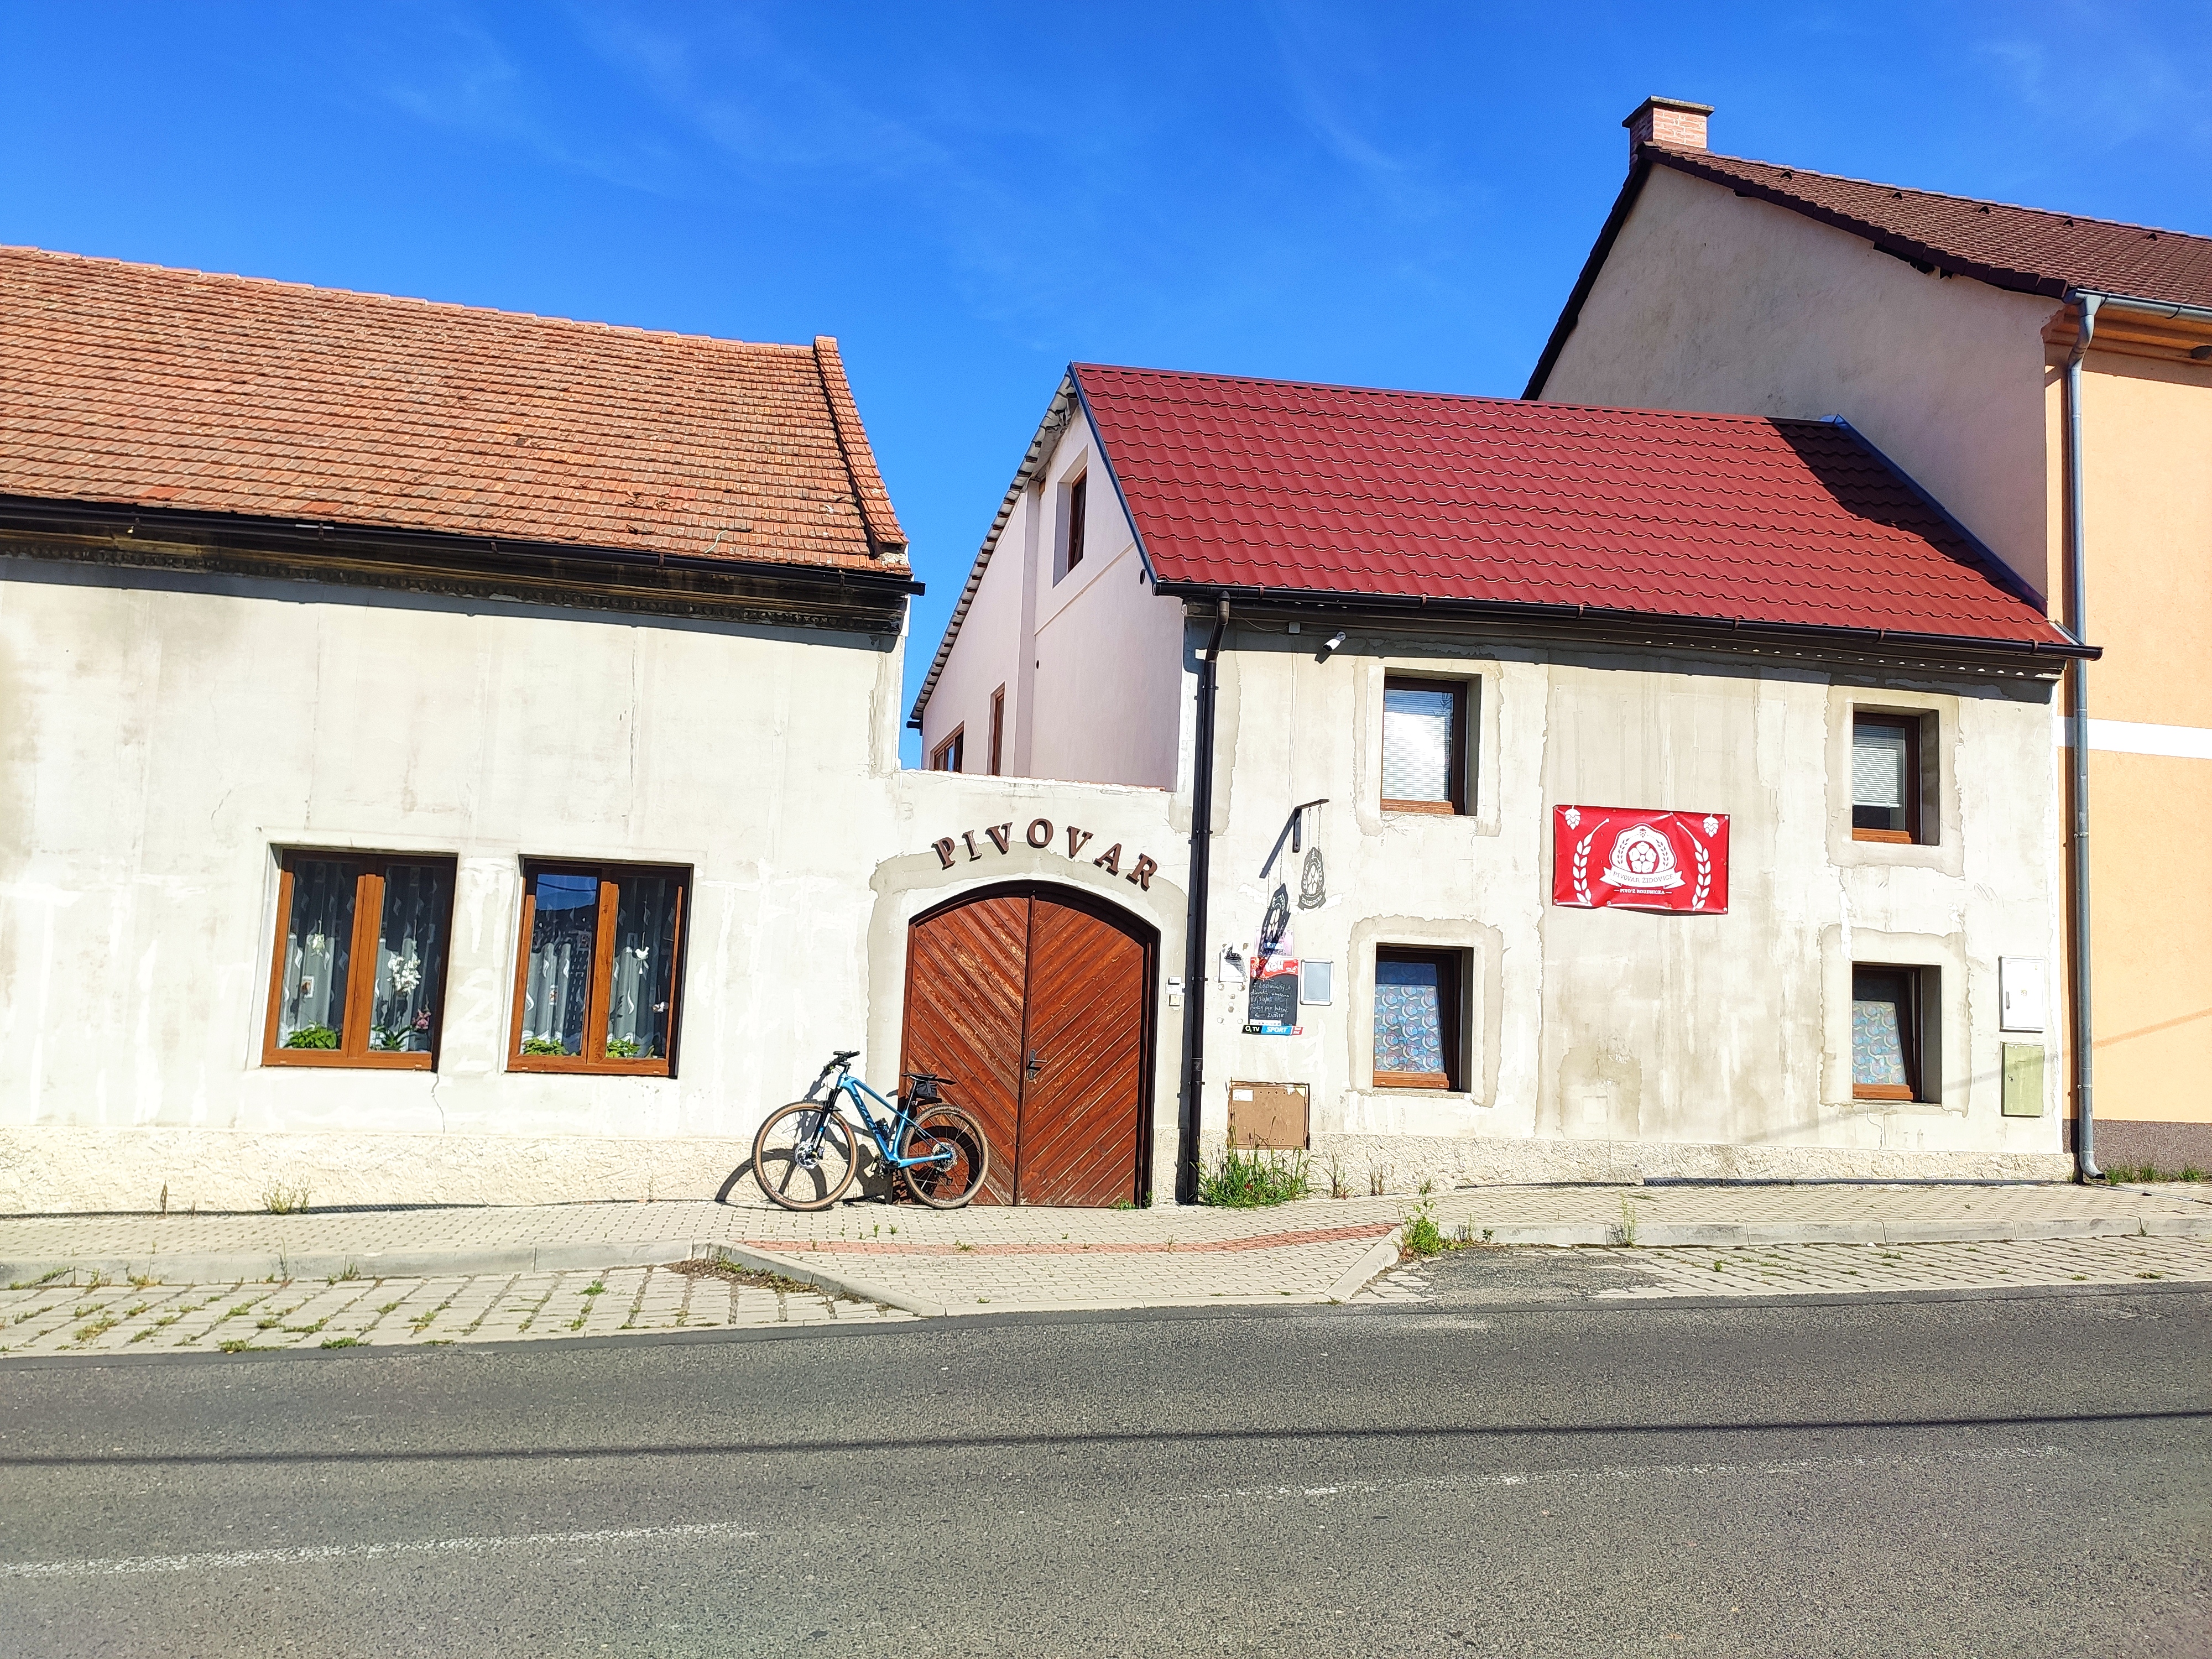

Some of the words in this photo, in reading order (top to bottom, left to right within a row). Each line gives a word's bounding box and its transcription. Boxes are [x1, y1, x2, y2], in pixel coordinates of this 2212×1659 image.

[931, 818, 1158, 892] PIVOVAR
[1613, 871, 1640, 883] PIVOVAR
[1642, 873, 1674, 883] ŽIDOVICE
